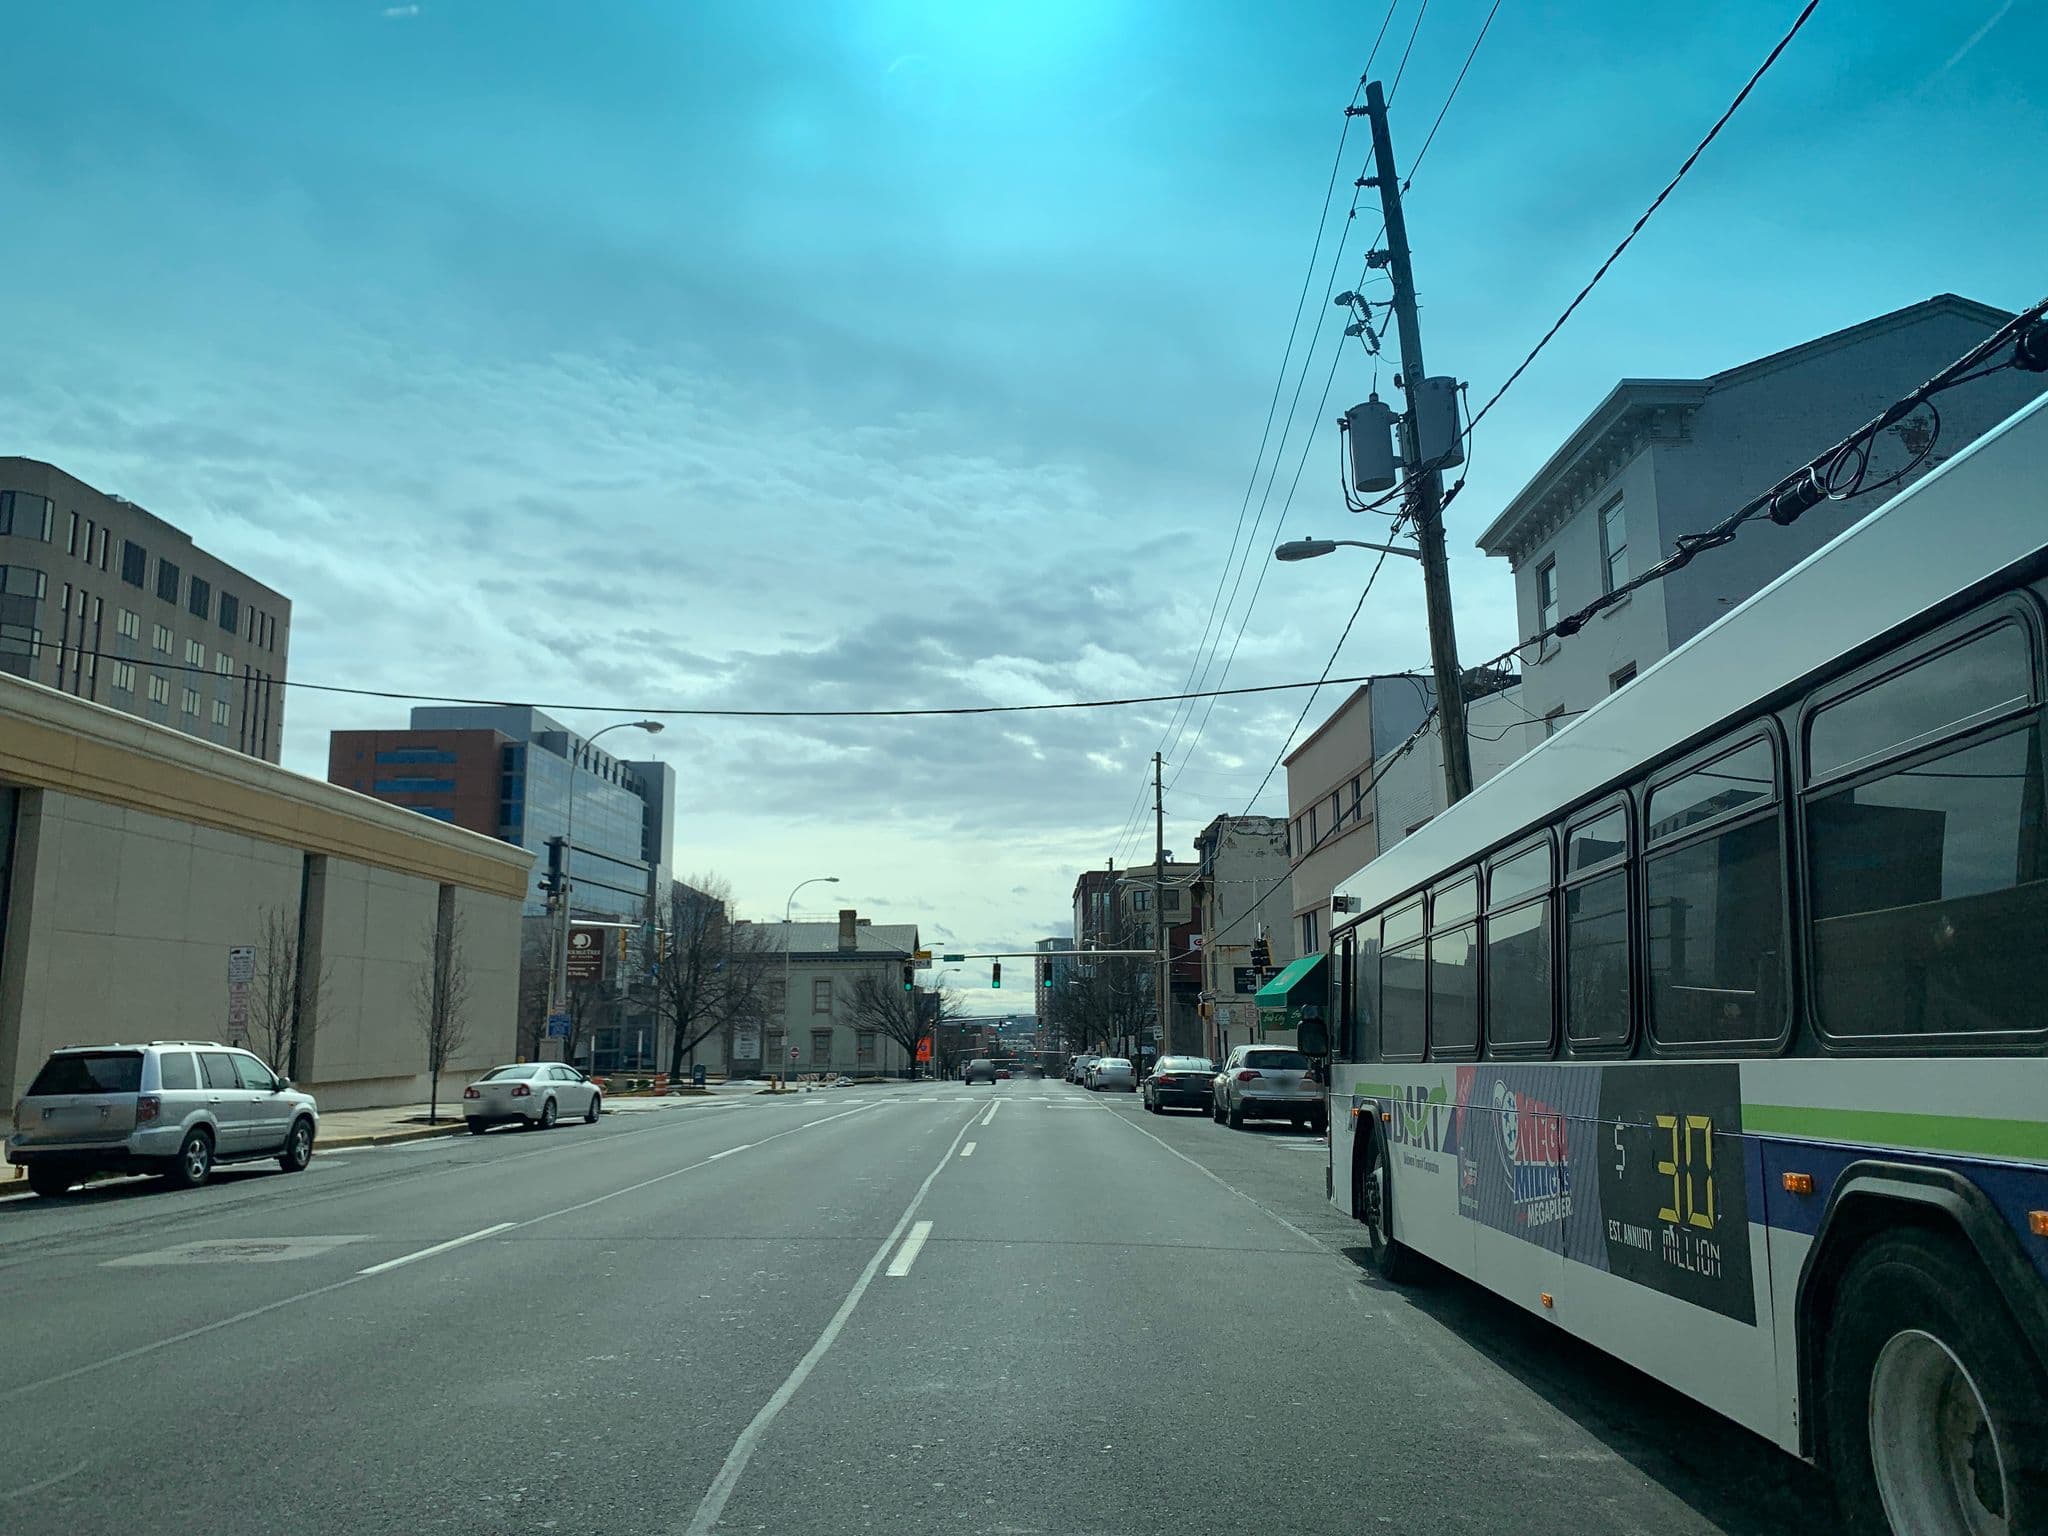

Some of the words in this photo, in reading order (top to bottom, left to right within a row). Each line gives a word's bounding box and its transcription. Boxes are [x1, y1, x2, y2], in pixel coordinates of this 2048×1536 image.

[1391, 1083, 1447, 1152] DART
[1514, 1090, 1569, 1164] MEGA
[1614, 1114, 1626, 1180] $
[1656, 1115, 1714, 1230] 30
[1609, 1218, 1624, 1243] EST.
[1624, 1222, 1653, 1252] ANNUITY
[1663, 1228, 1721, 1279] MILLION
